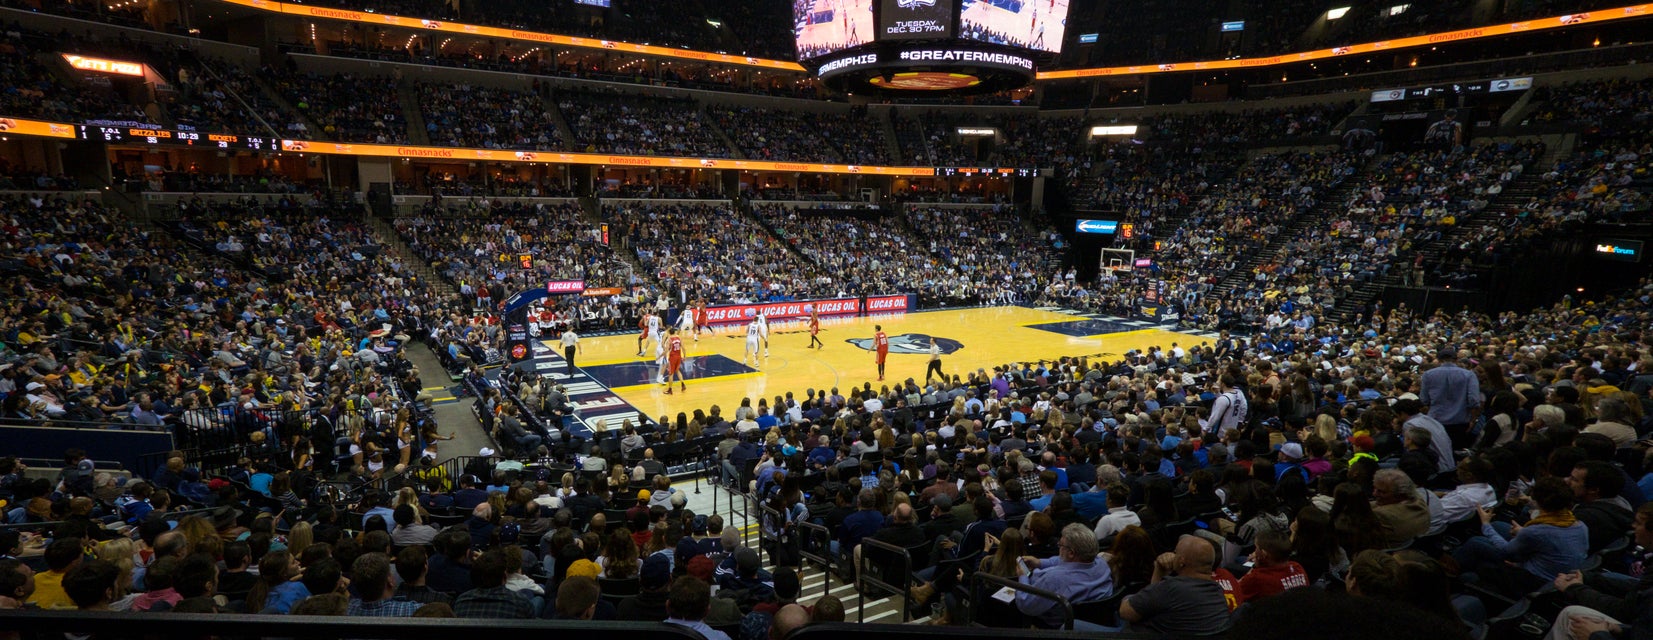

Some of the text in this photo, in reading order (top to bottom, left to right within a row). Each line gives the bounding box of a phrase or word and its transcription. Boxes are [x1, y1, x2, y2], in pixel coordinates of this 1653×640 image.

[900, 50, 1033, 69] #GREATERMEMPHIS
[112, 63, 141, 73] PIZZA
[129, 129, 171, 138] GRIZZLIES
[208, 134, 238, 143] ROCKETS
[398, 147, 453, 157] Cinnasnacks
[572, 281, 583, 289] OIL
[817, 301, 855, 312] LUCAS OIL
[870, 298, 905, 309] LUCAS OIL
[728, 309, 742, 319] OIL
[788, 304, 801, 314] OIL
